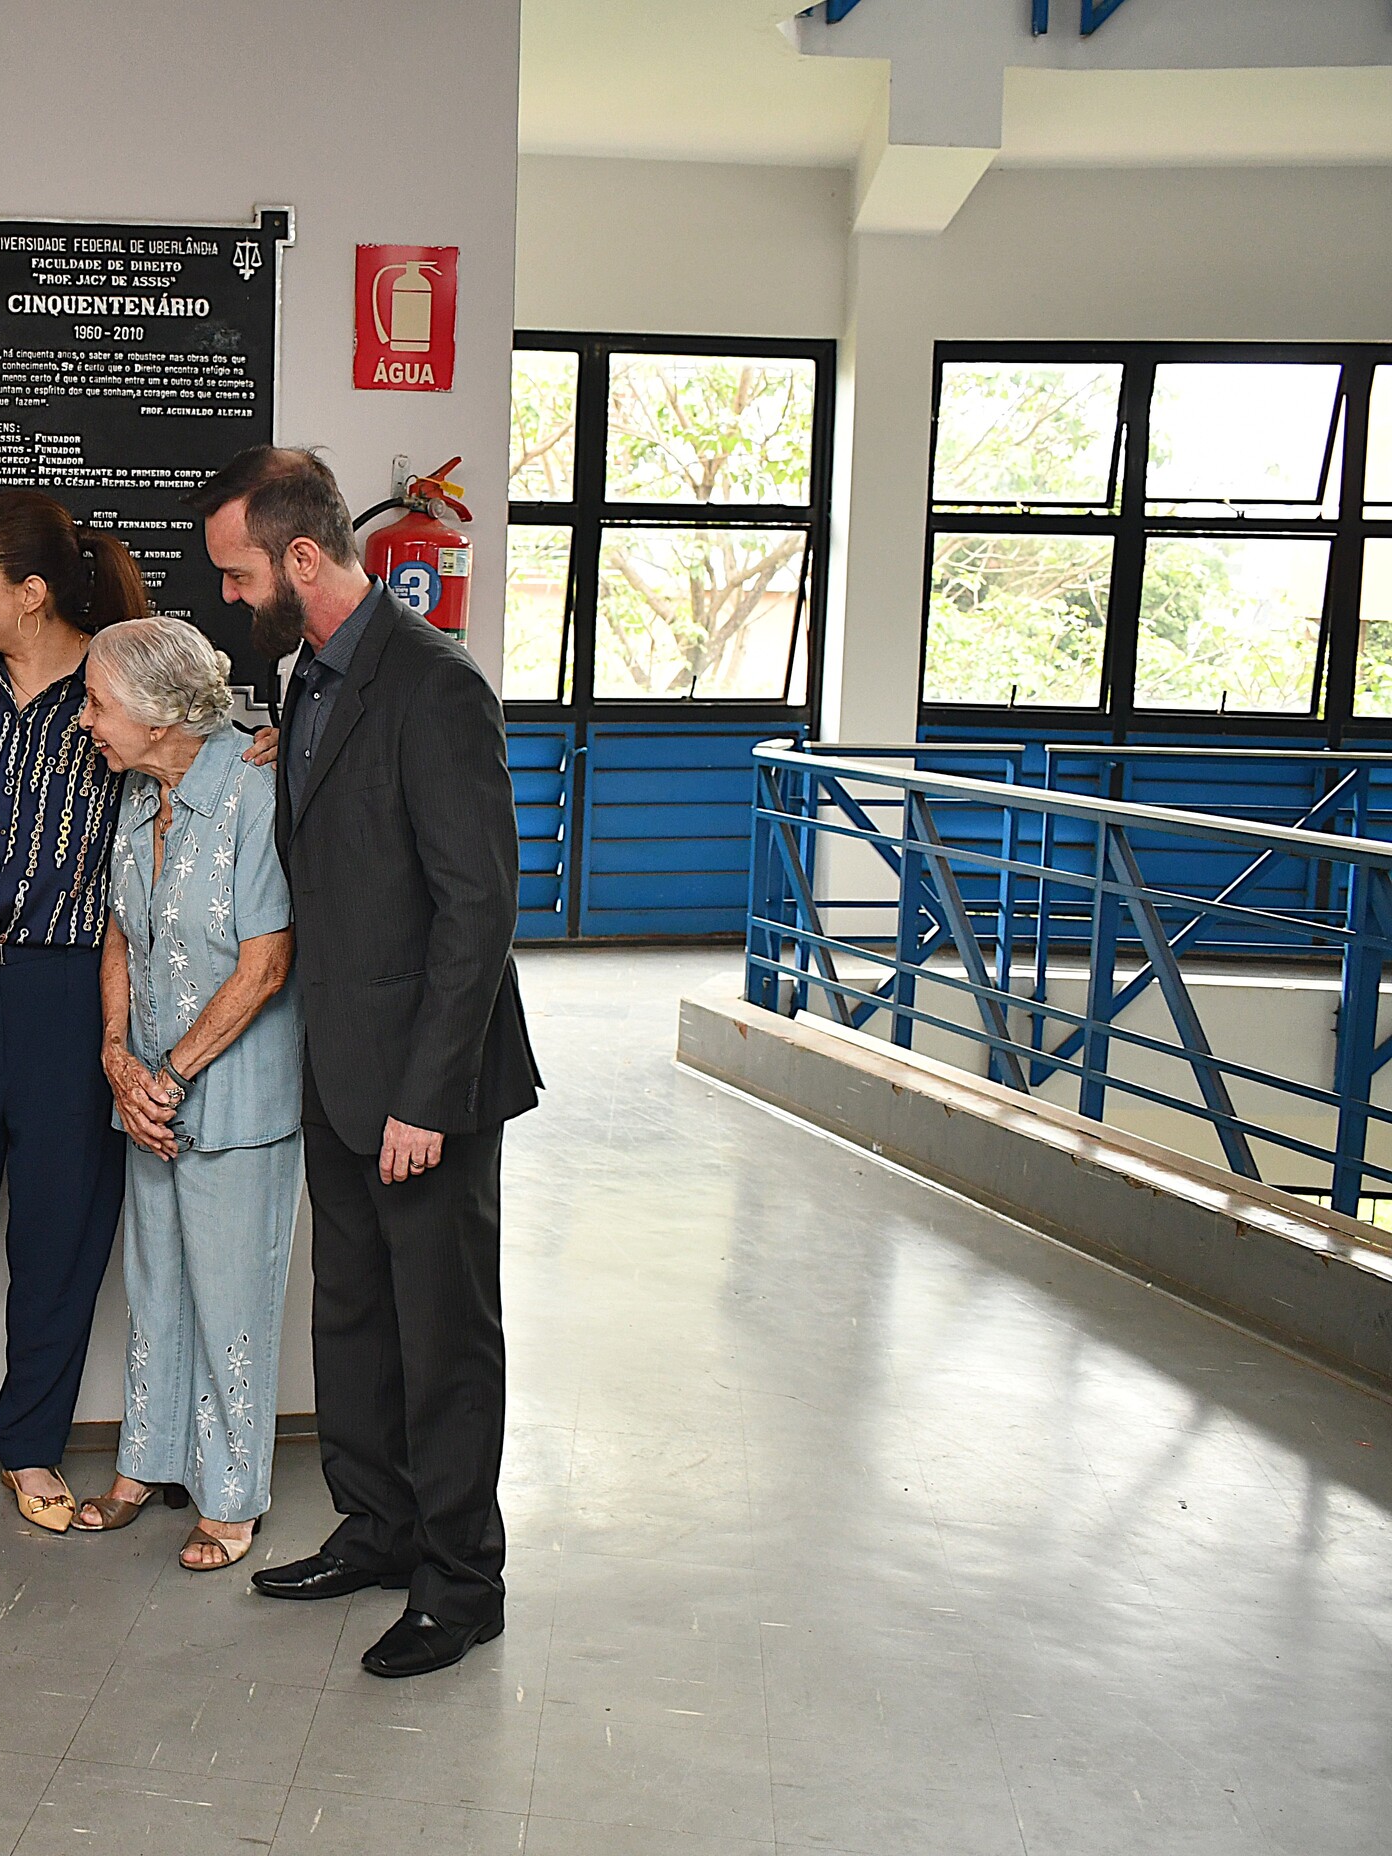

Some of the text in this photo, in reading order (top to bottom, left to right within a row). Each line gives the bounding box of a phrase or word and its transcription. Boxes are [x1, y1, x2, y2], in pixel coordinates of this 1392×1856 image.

[73, 237, 127, 253] FEDERAL
[129, 239, 146, 254] DE
[148, 236, 219, 256] UBERLÂNDIA
[32, 258, 181, 271] FACULDADE DE DIREITO
[76, 275, 107, 285] JACY
[112, 276, 127, 286] DE
[7, 292, 210, 317] CINQUENTENÁRIO
[373, 357, 435, 384] ÁGUA
[400, 569, 430, 615] 3
